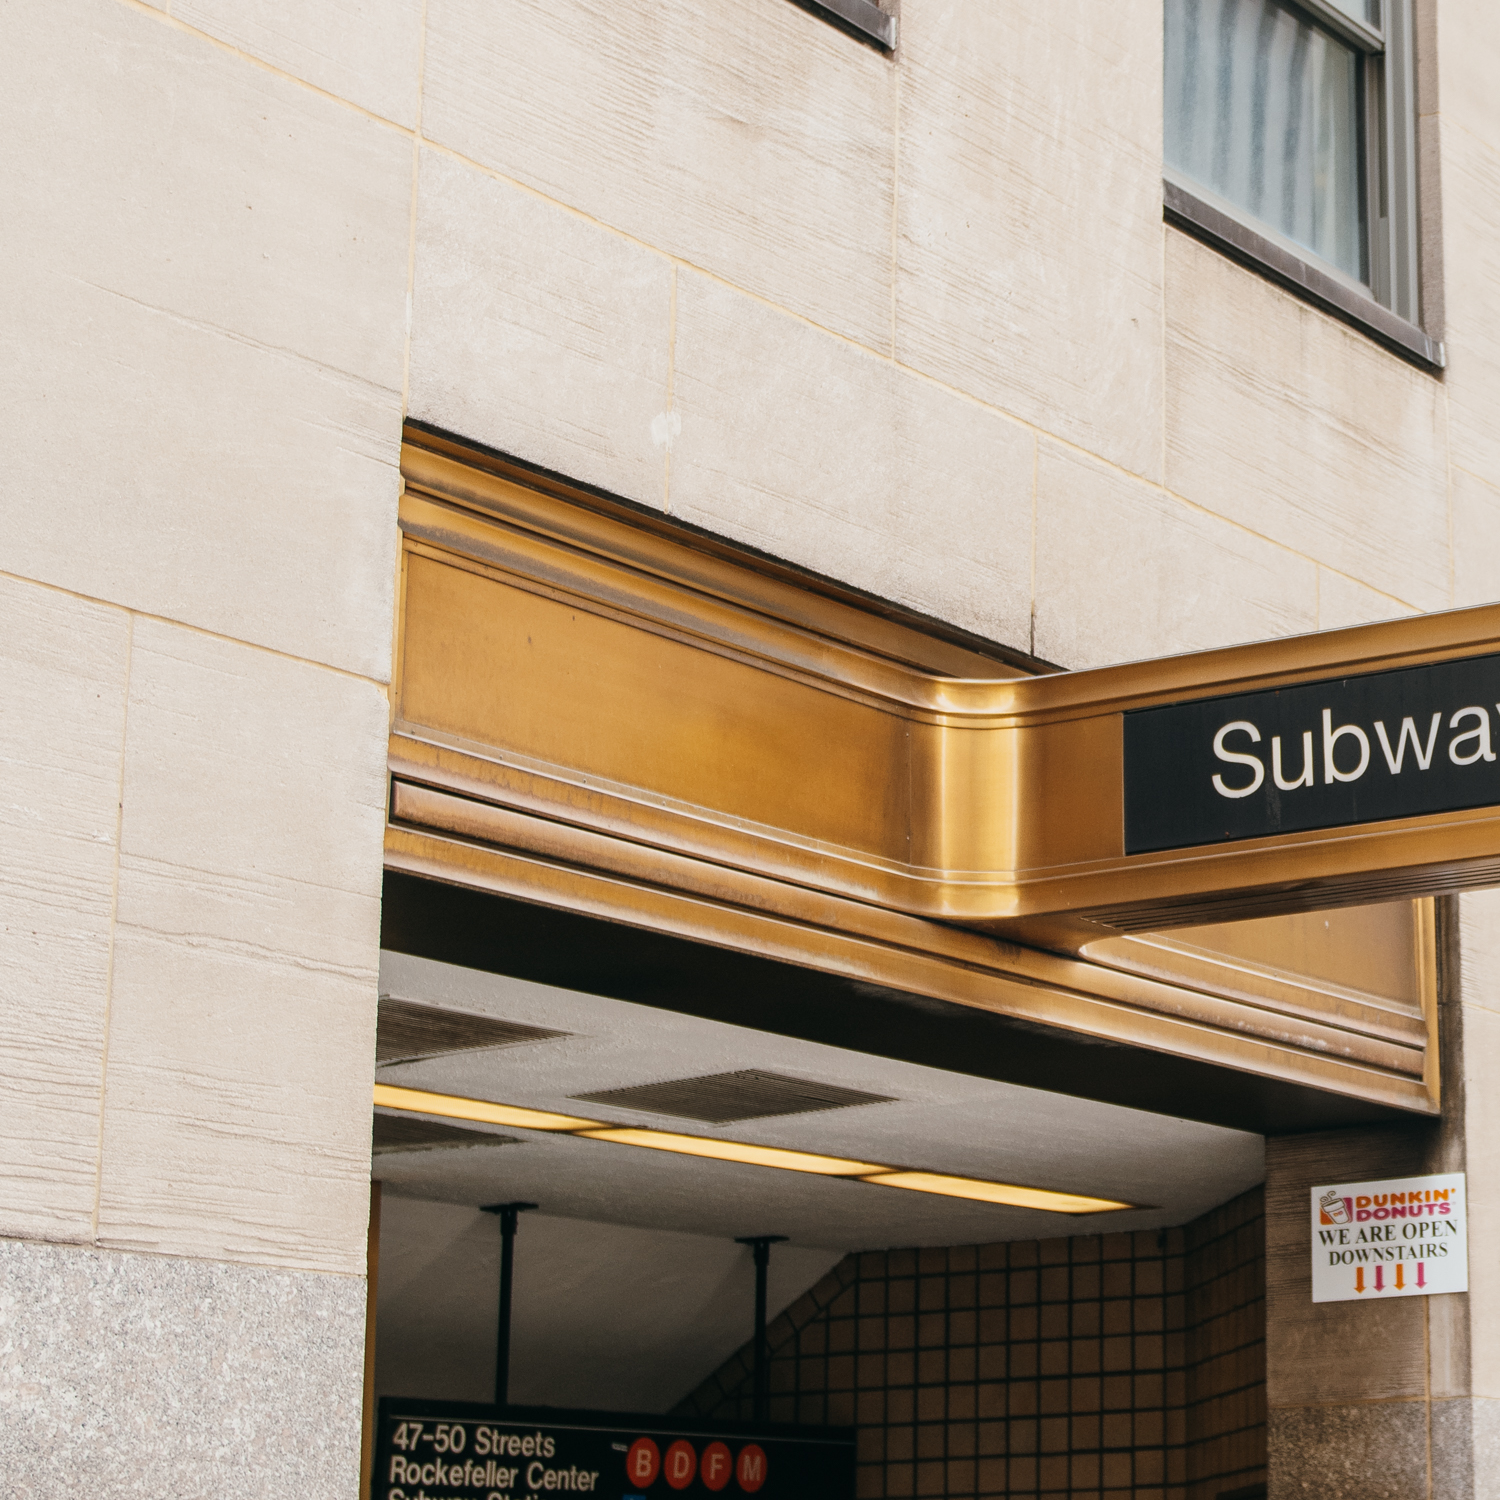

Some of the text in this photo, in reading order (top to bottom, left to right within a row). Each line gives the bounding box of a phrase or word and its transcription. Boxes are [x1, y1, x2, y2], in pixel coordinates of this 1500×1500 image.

[1356, 1188, 1456, 1209] DUNKIN'
[1356, 1202, 1451, 1222] DONUTS
[1318, 1219, 1458, 1246] WE ARE OPEN
[1328, 1242, 1448, 1266] DOWNSTAIRS
[393, 1422, 555, 1458] 47-50 Streets
[389, 1455, 599, 1491] Rockefeller Center
[636, 1449, 761, 1481] B D F M
